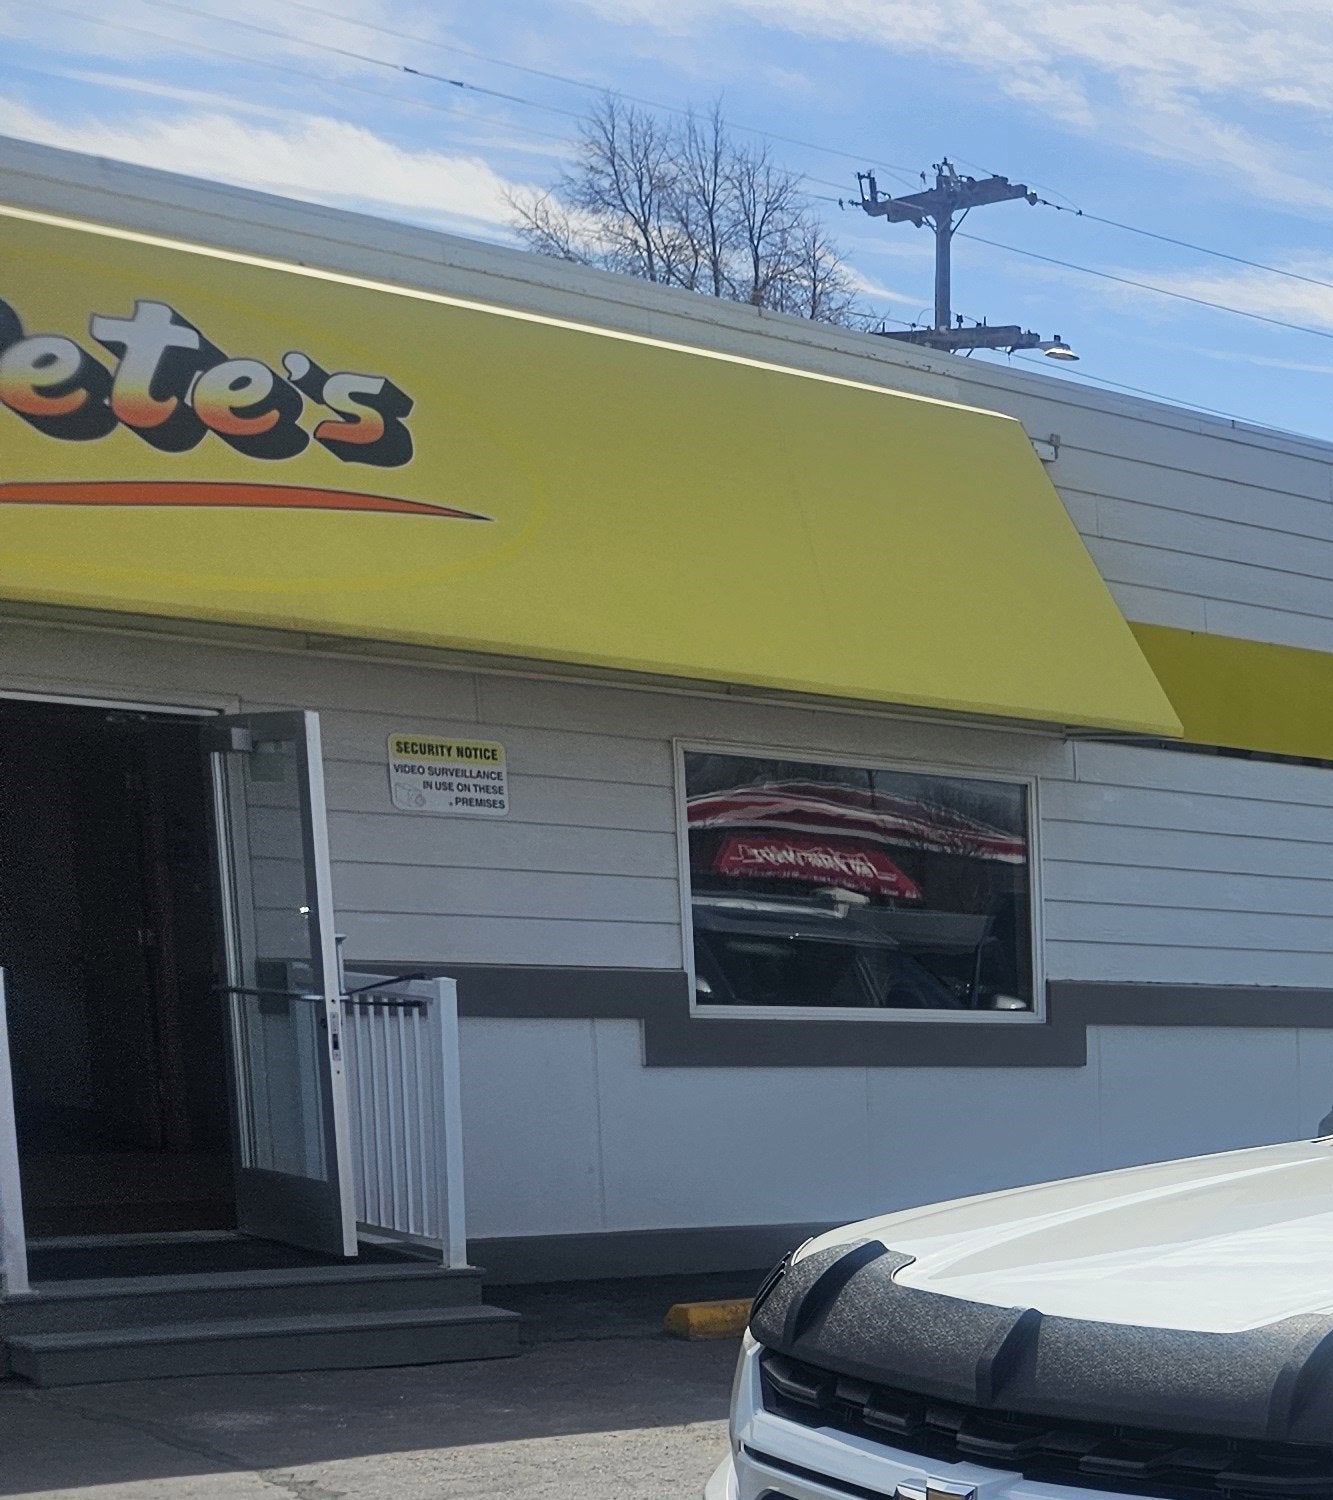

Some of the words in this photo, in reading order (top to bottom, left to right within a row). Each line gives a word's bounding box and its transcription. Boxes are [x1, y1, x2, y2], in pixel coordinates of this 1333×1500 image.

[0, 299, 414, 468] ete's
[395, 741, 453, 758] SECURITY
[456, 746, 499, 761] NOTICE
[393, 764, 426, 776] VIDEO
[427, 766, 504, 781] SURVEILLANCE
[422, 780, 433, 790] IN
[434, 781, 455, 792] USE
[456, 783, 471, 793] ON
[472, 784, 504, 795] THESE
[454, 796, 506, 810] PREMISES
